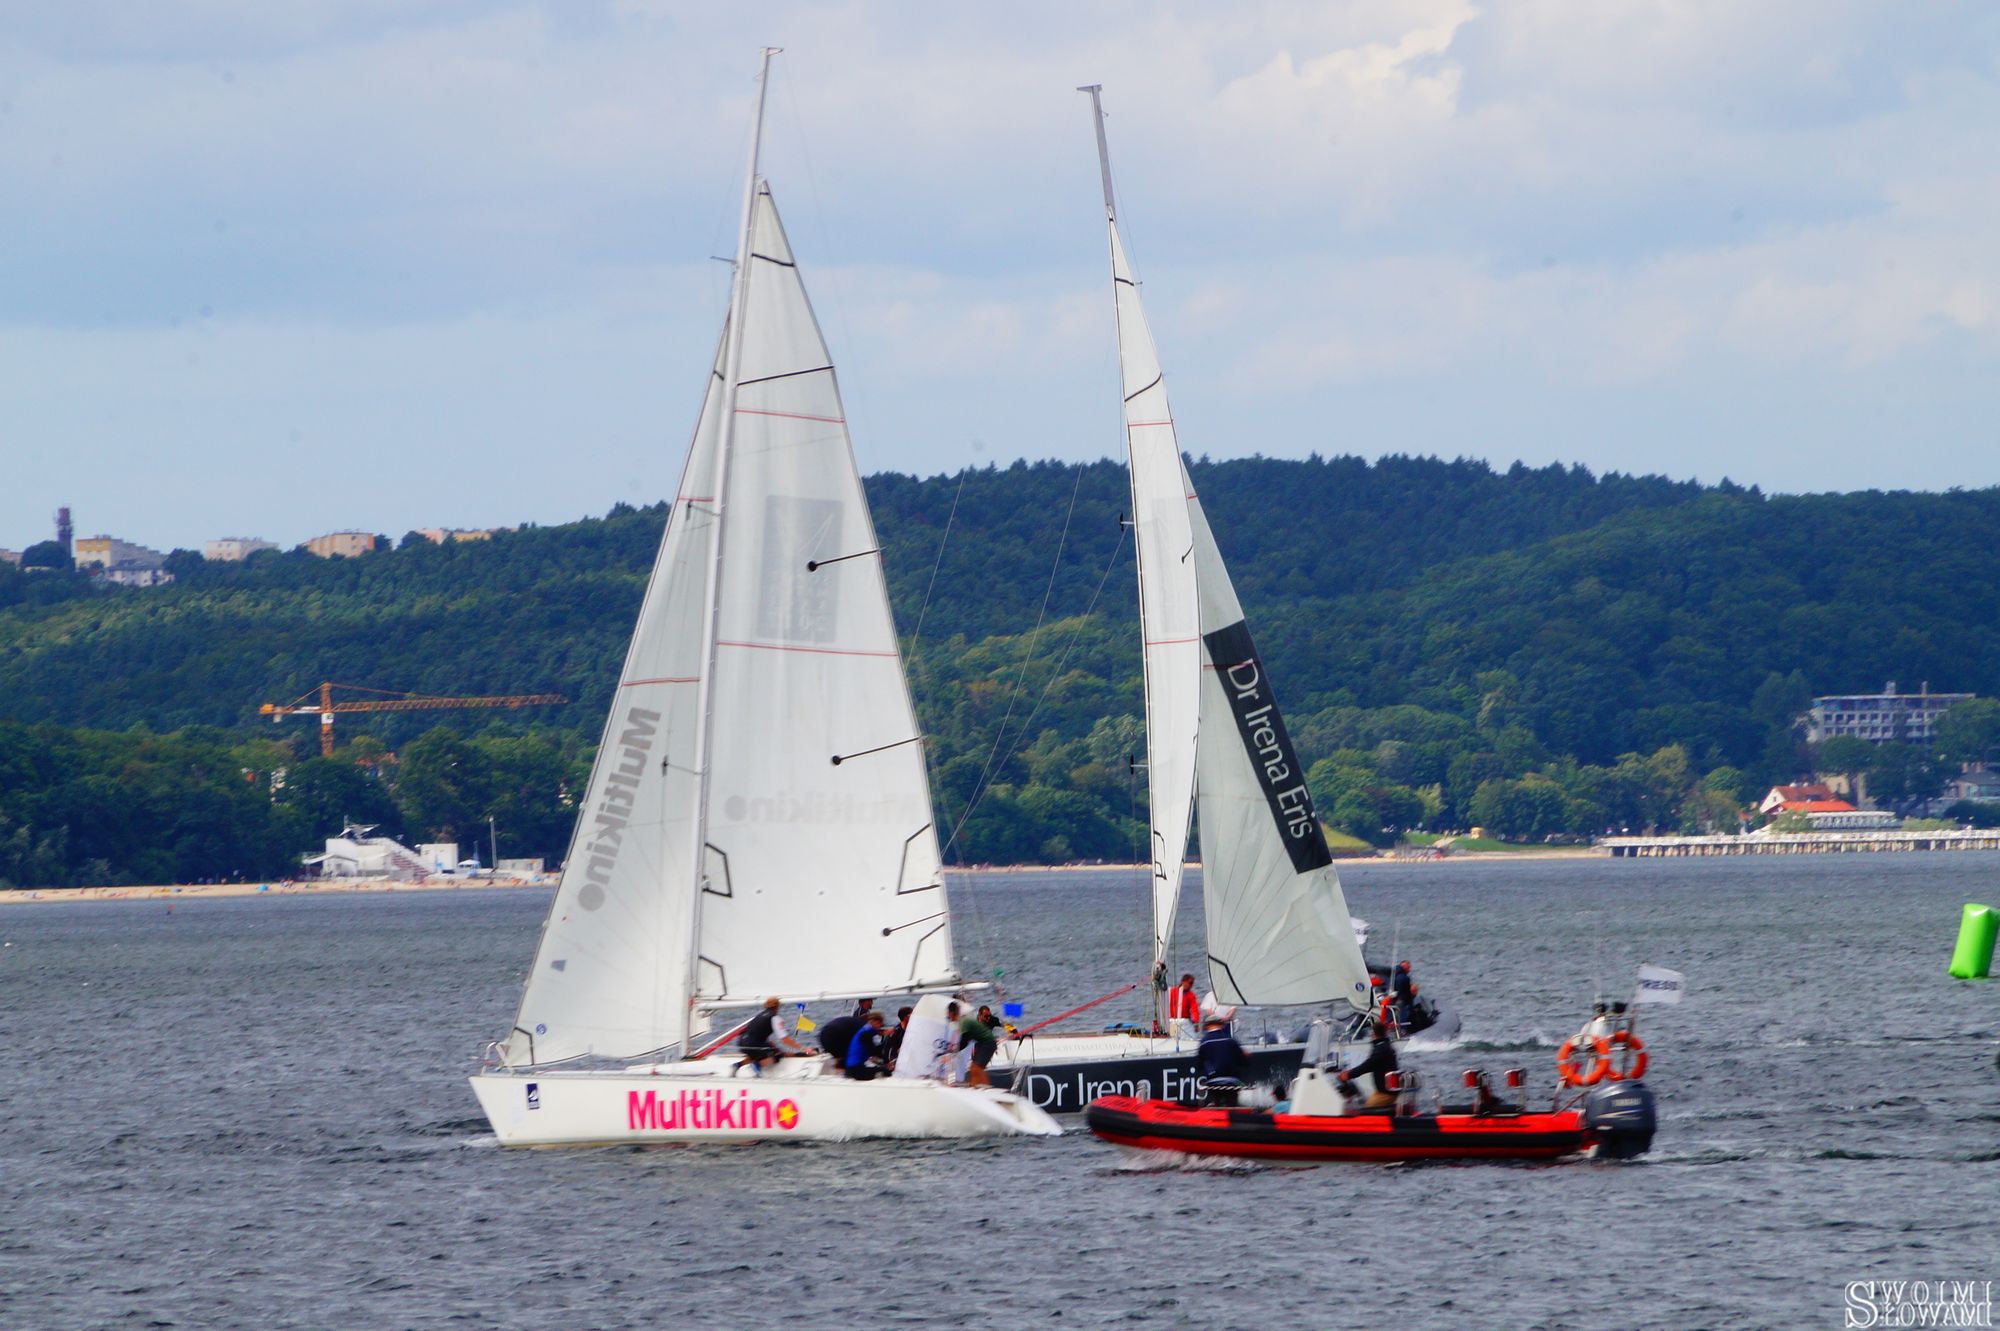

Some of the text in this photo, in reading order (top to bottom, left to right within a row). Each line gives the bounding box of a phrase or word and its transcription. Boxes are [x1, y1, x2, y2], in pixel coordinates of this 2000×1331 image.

[1227, 658, 1316, 839] Dr Irena Eris
[628, 1089, 798, 1130] Multikino
[1027, 1074, 1068, 1107] Dr
